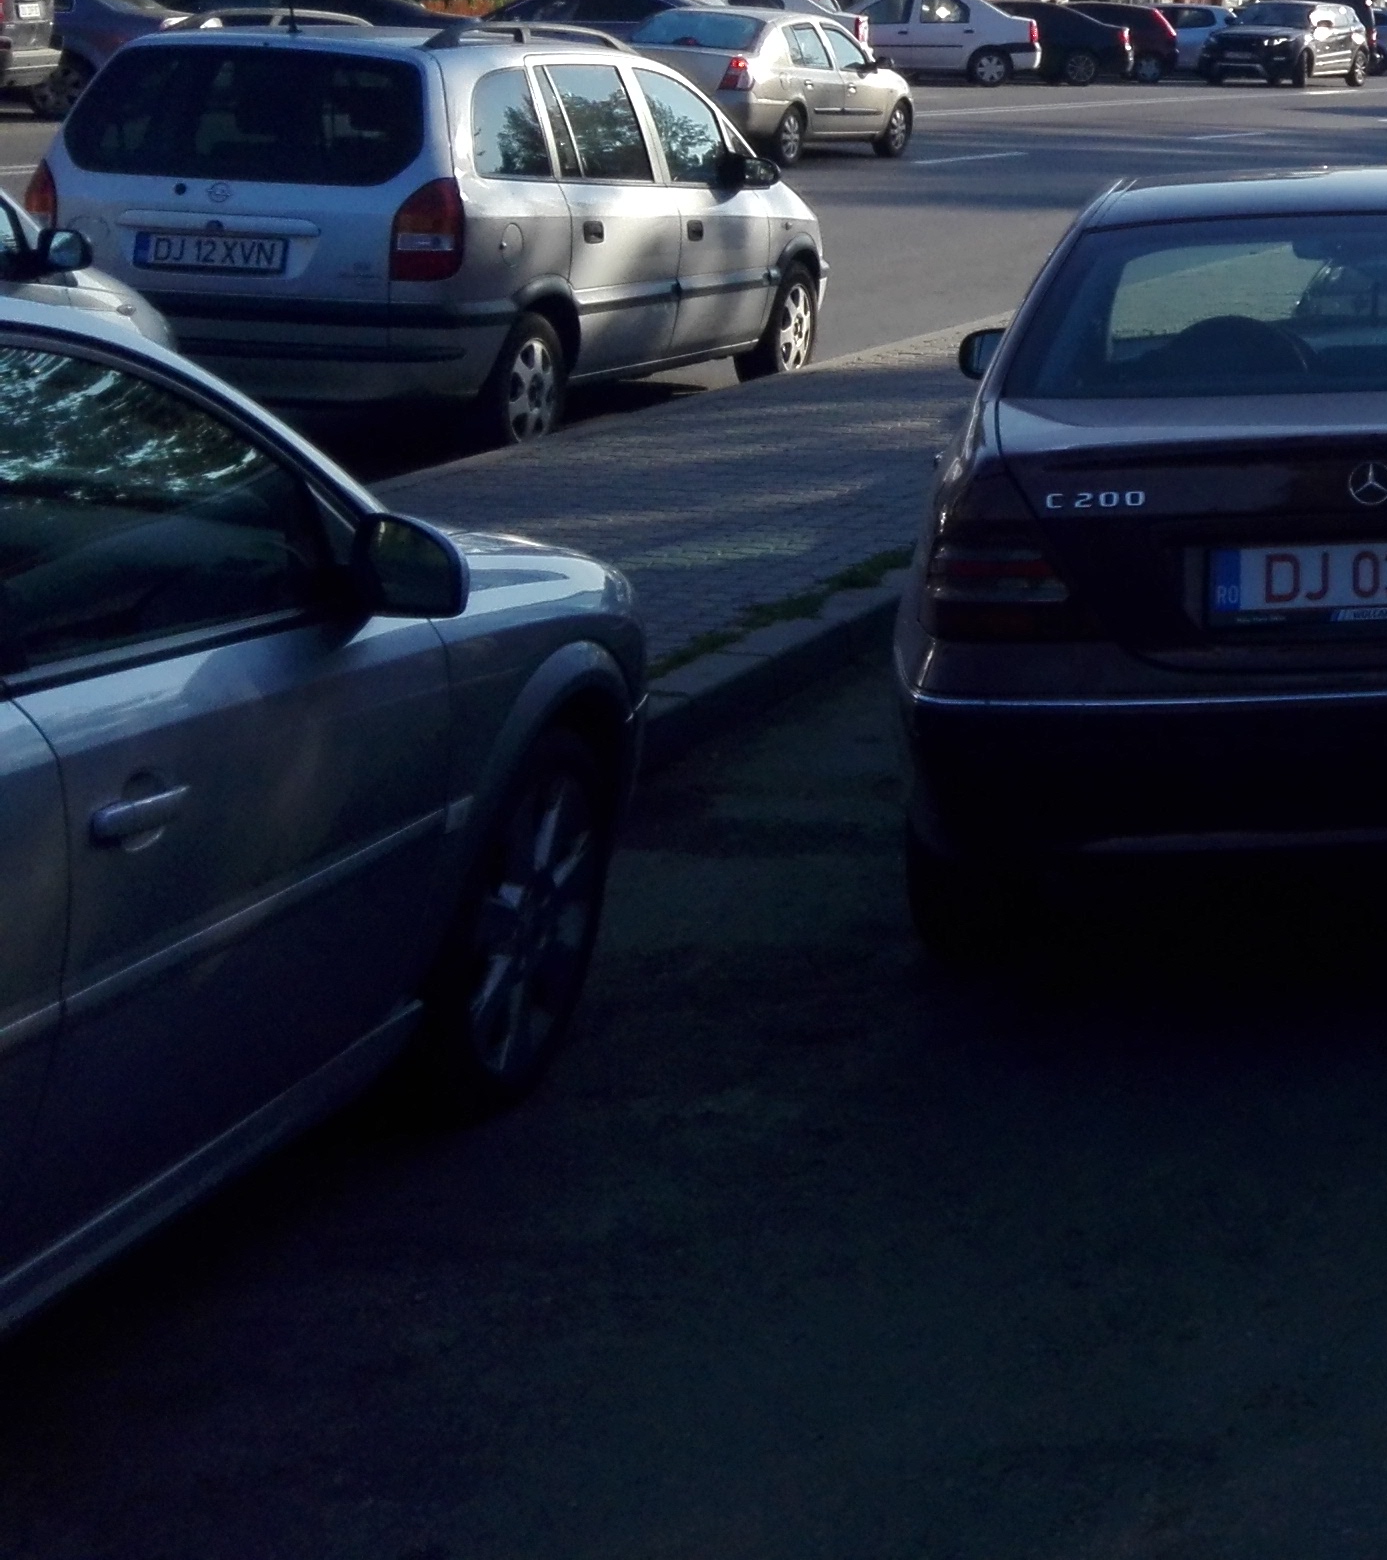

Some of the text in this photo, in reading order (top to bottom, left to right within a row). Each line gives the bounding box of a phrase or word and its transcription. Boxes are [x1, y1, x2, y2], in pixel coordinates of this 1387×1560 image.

[153, 238, 186, 262] DJ
[1216, 585, 1238, 605] RO
[1264, 552, 1330, 604] DJ
